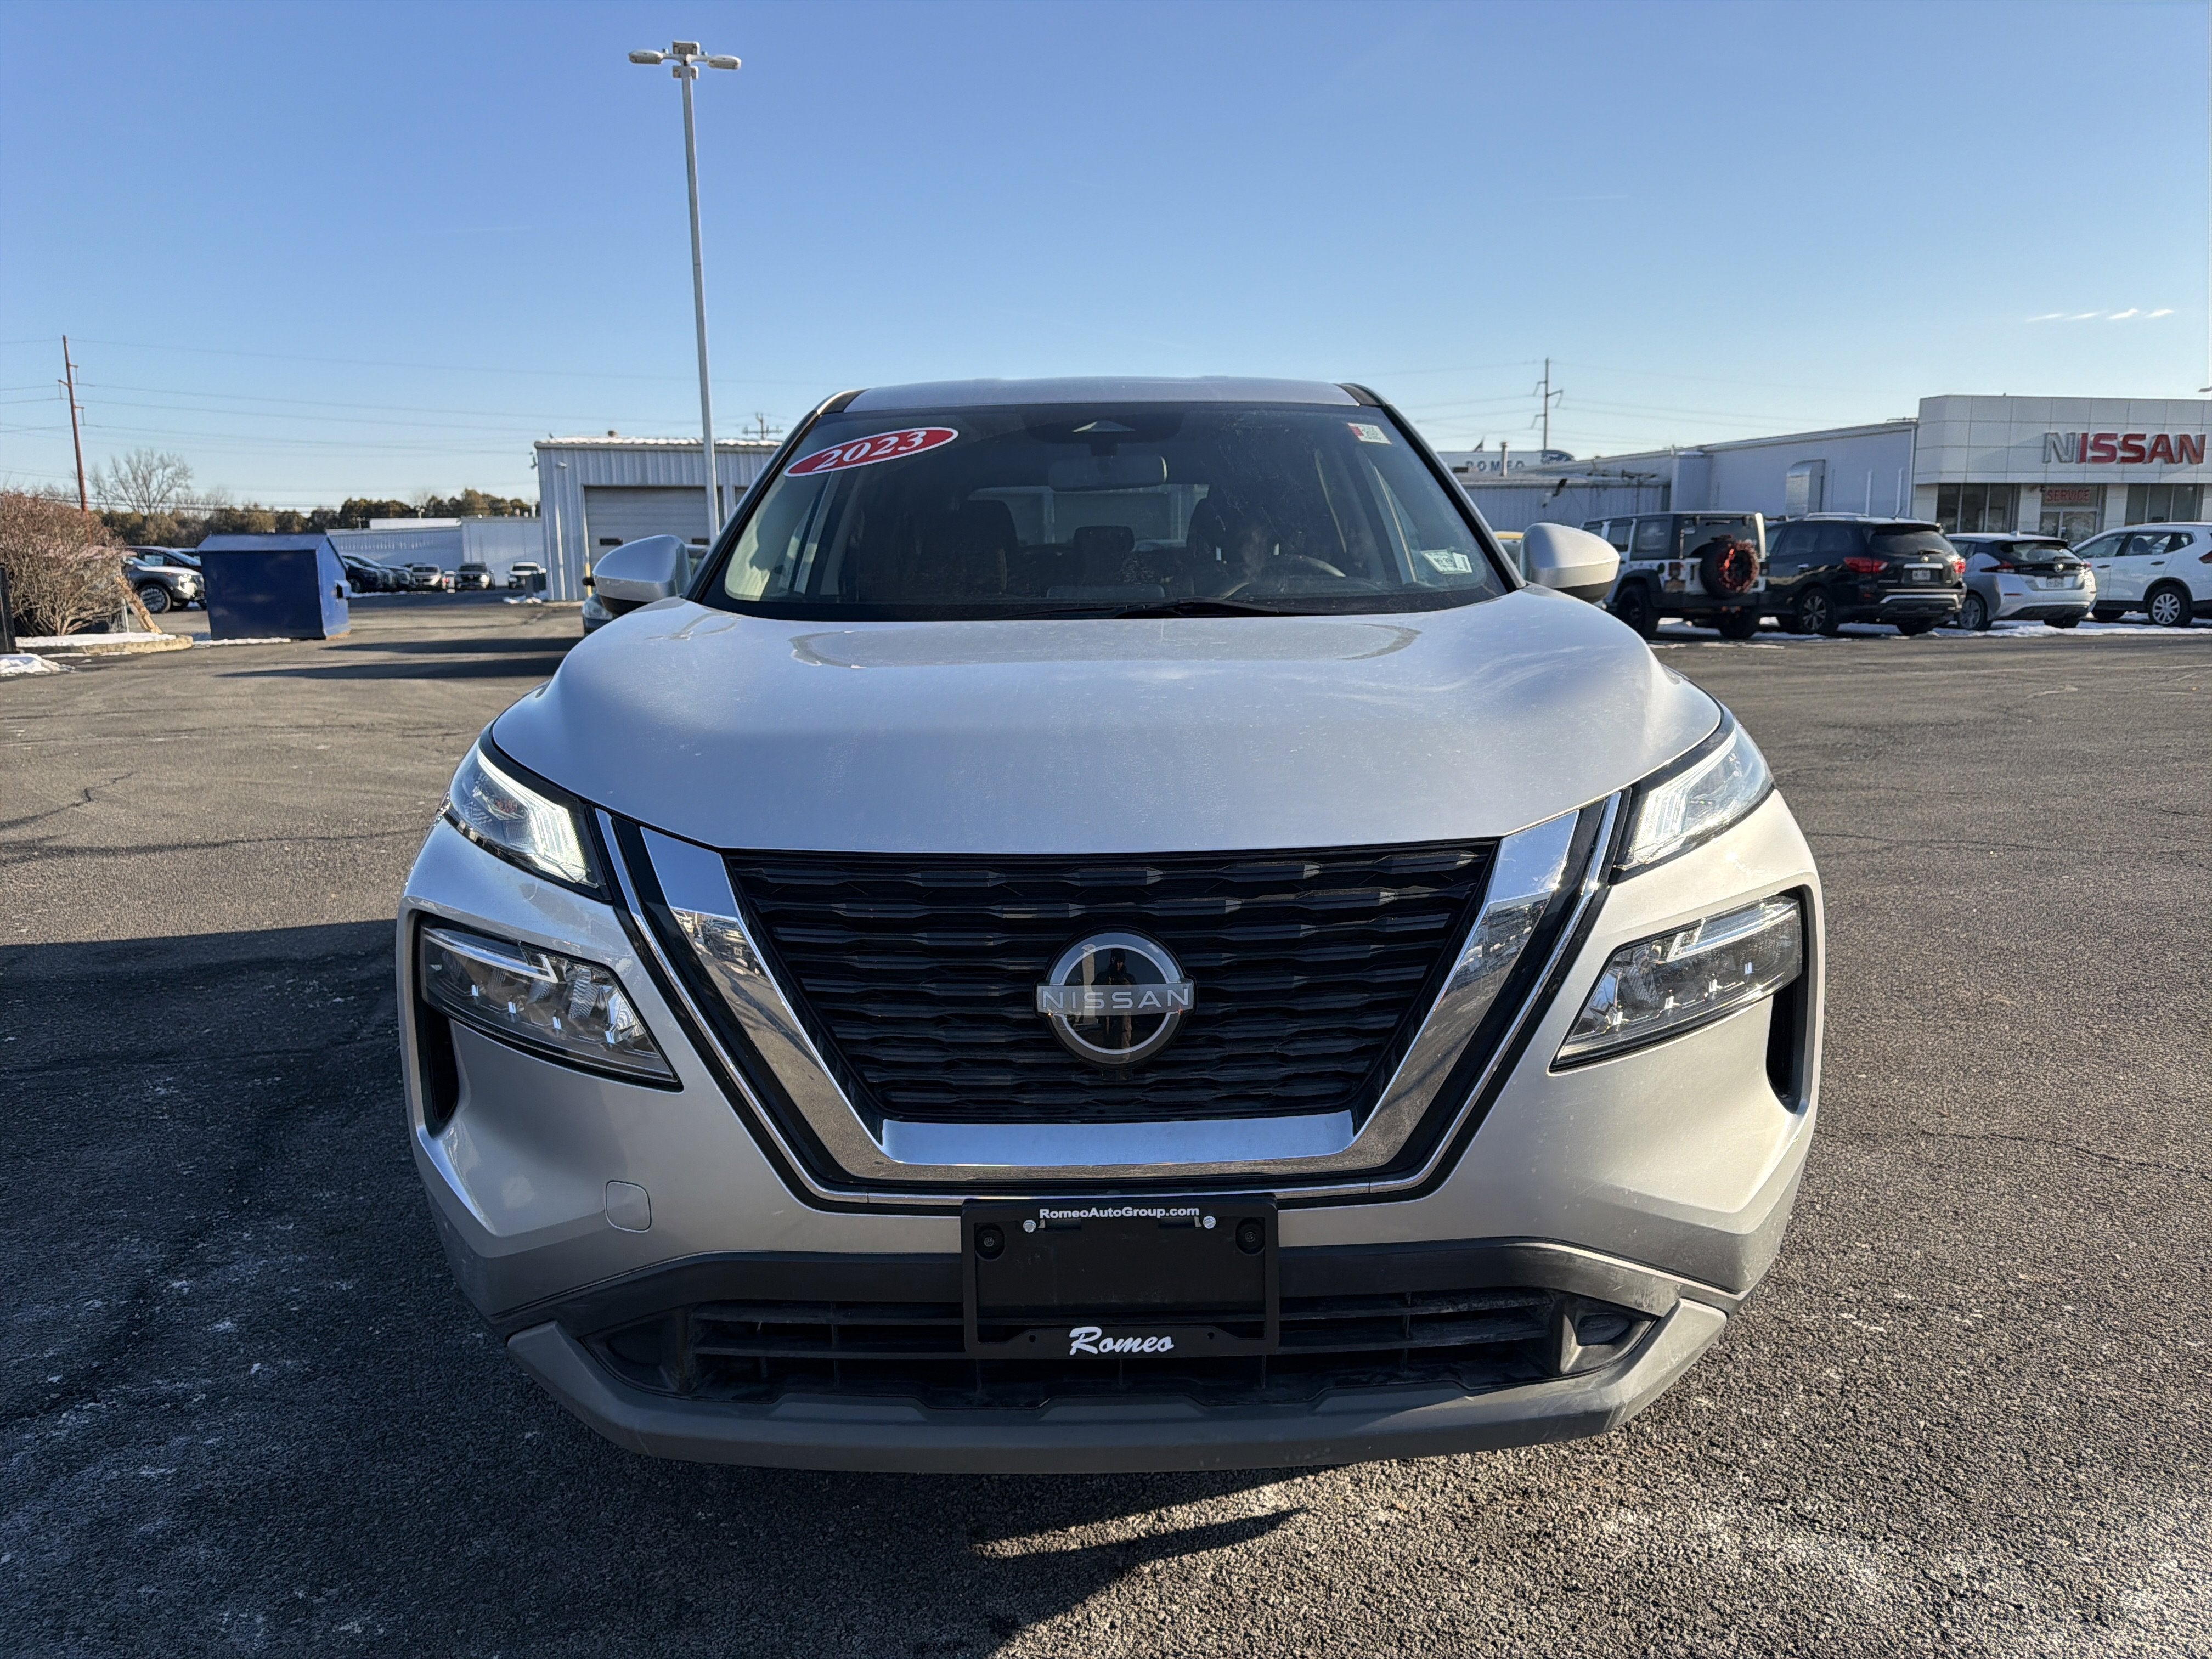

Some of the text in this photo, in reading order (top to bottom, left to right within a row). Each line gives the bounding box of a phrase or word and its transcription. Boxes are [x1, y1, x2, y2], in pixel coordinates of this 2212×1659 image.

[812, 431, 927, 471] 2023
[2042, 432, 2207, 464] NISSAN
[1465, 461, 1525, 472] ROMO
[2047, 489, 2090, 502] SERVICE
[1042, 988, 1189, 1009] NISSAN
[1039, 1207, 1200, 1218] RomeoAutoGroup.com
[1069, 1326, 1174, 1355] Romeo
